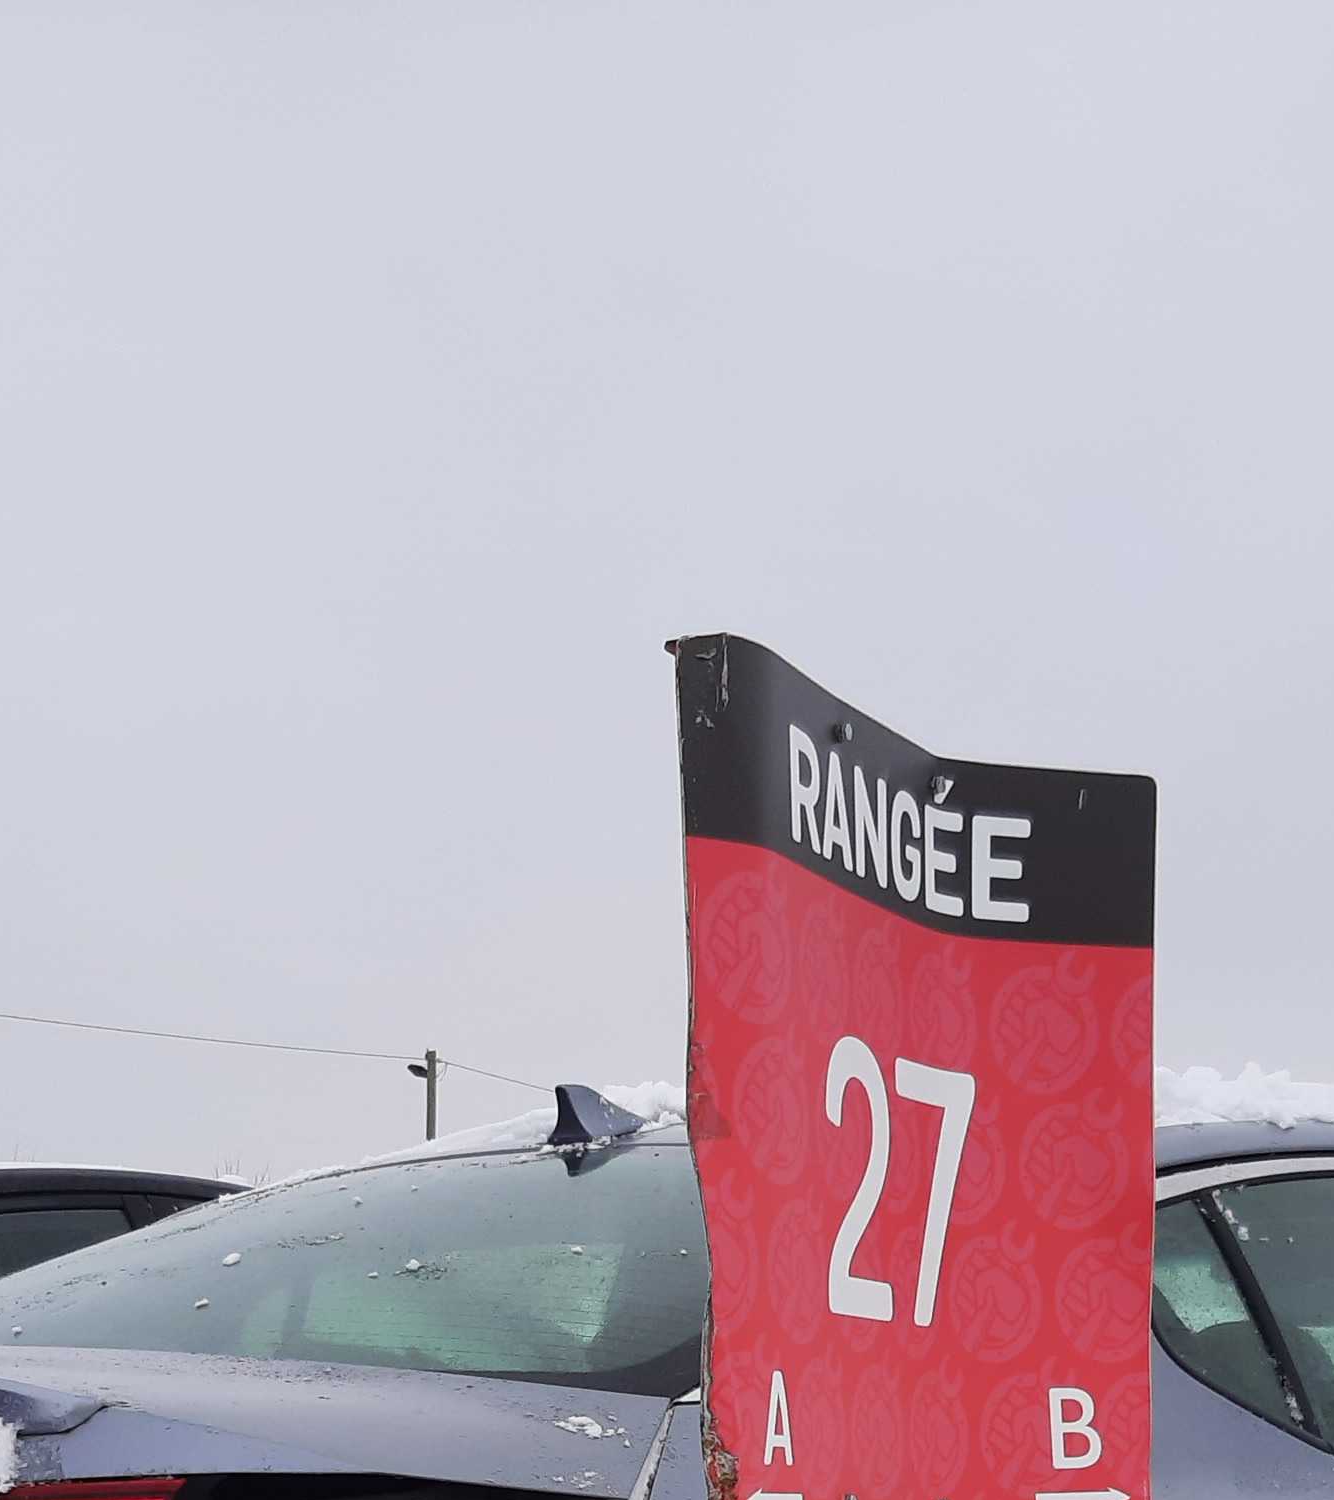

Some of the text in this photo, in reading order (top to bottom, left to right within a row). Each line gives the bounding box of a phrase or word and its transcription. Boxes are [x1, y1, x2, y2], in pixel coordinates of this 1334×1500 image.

[789, 724, 1032, 923] RANGÉE
[825, 1035, 977, 1327] 27
[763, 1370, 794, 1466] A
[1048, 1387, 1103, 1470] B
